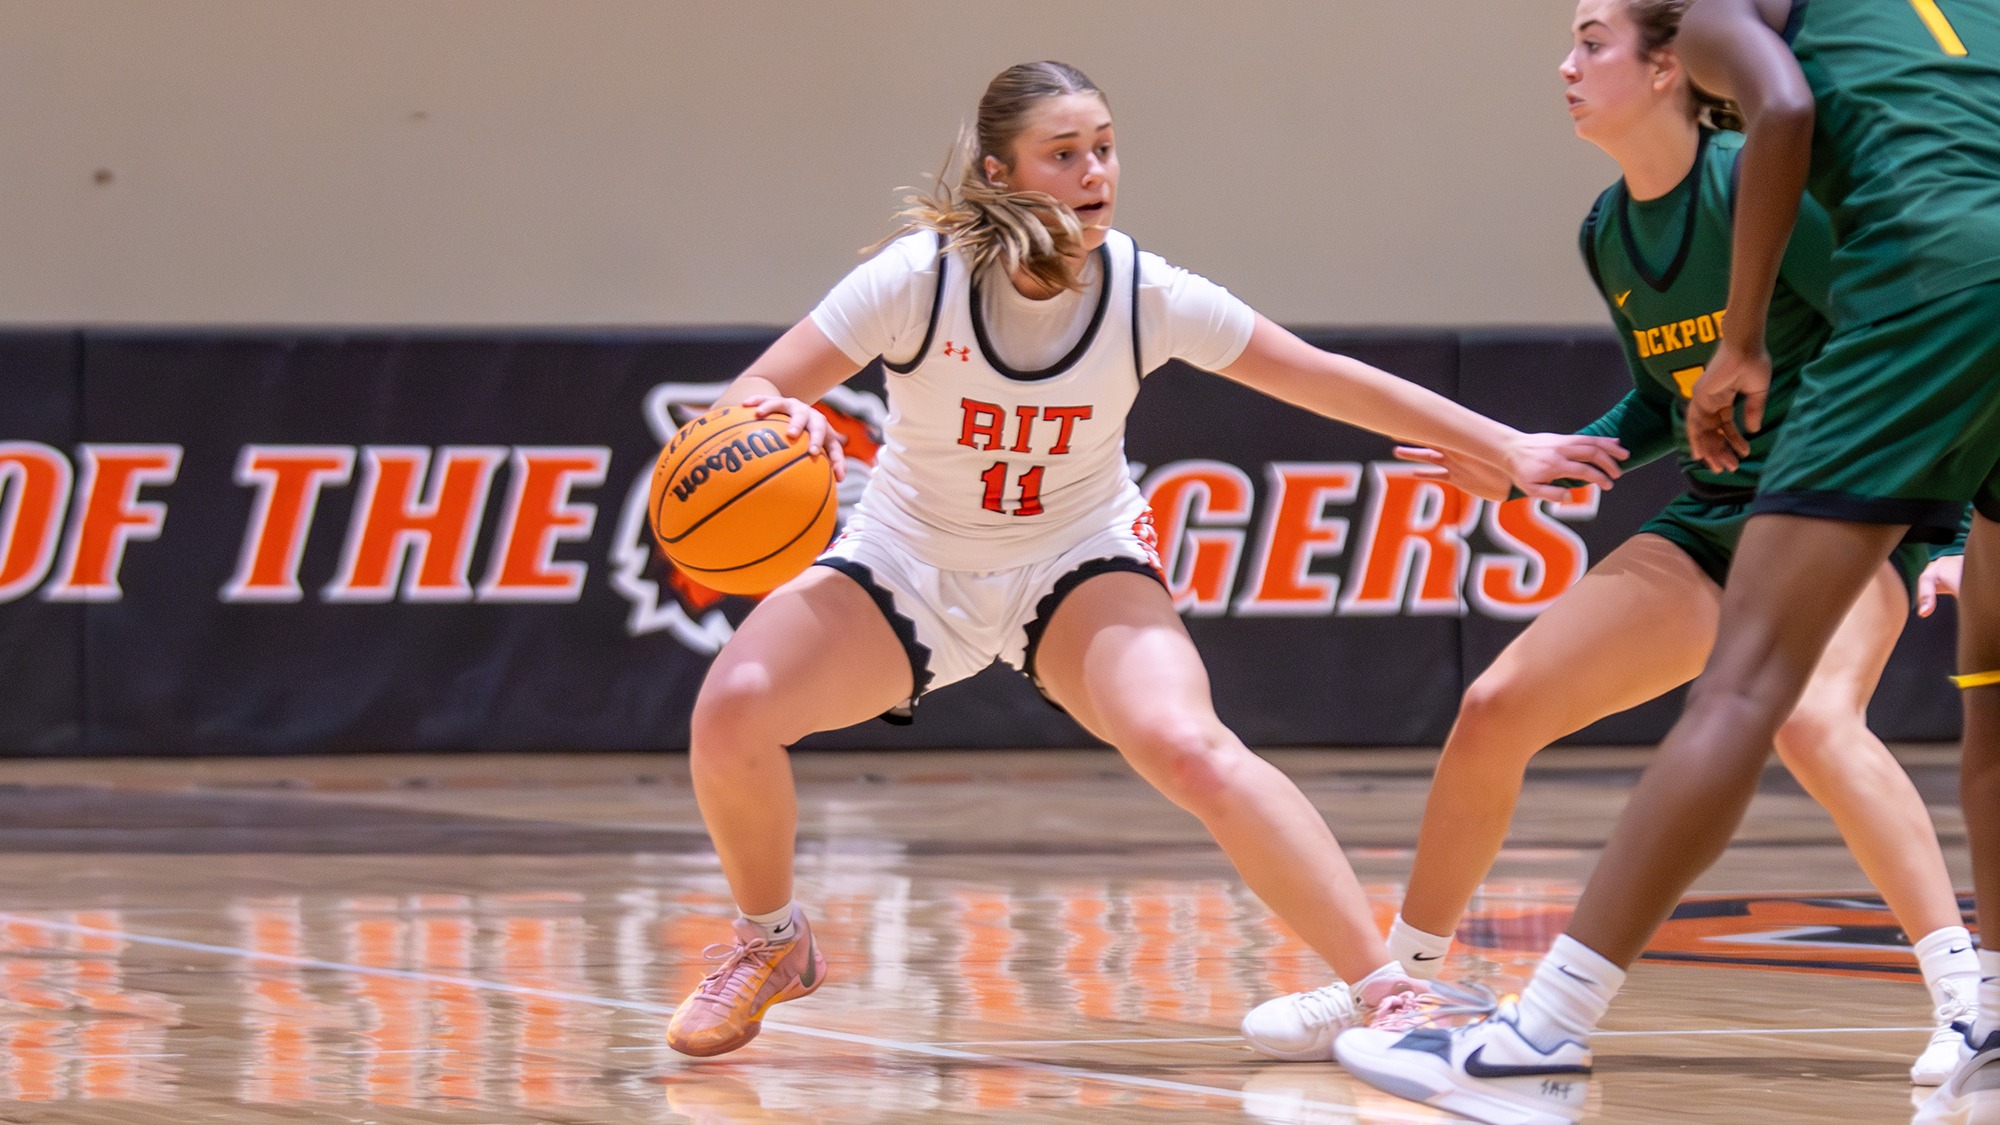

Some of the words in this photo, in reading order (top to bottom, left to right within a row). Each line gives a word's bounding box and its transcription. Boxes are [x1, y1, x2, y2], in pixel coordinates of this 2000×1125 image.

[957, 397, 1093, 455] RIT
[672, 428, 790, 502] Wilson
[981, 461, 1045, 516] 11
[218, 444, 611, 602] THE
